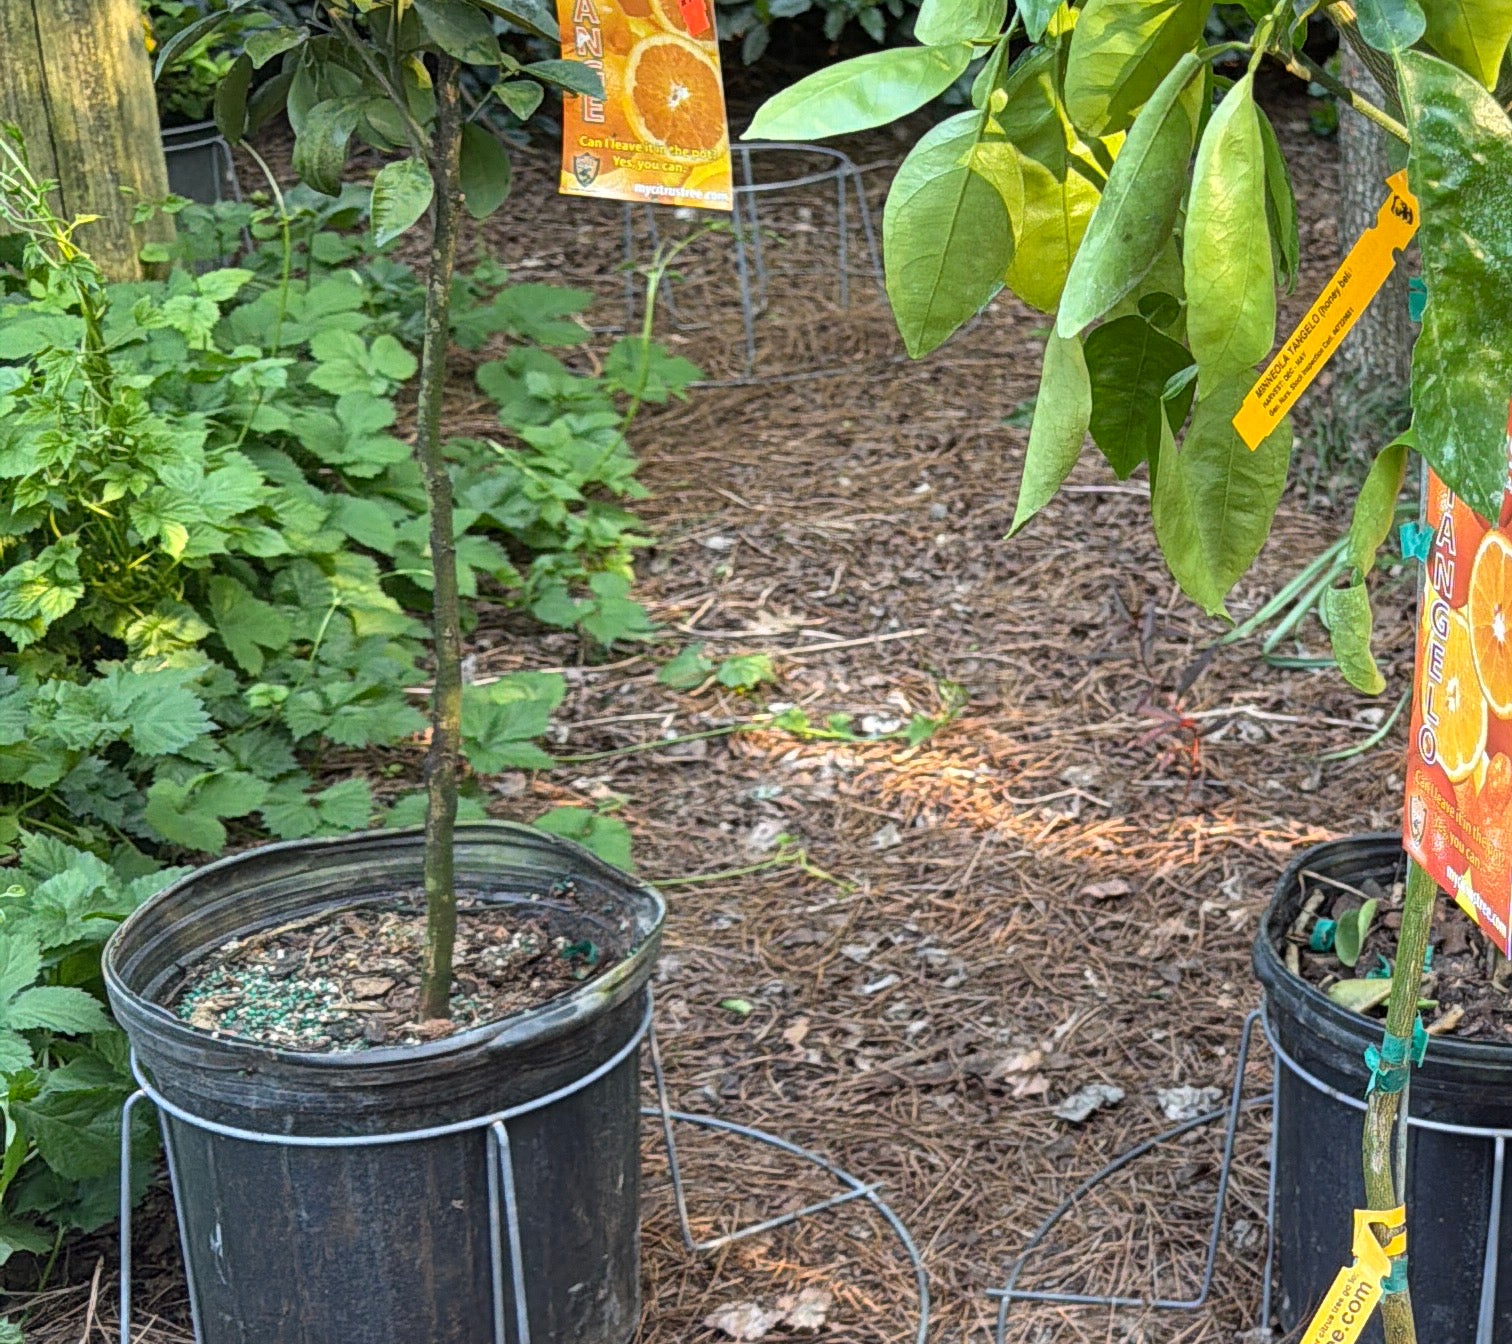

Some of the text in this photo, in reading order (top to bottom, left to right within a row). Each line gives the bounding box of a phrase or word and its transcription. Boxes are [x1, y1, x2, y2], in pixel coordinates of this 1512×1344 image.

[578, 135, 602, 148] Can
[611, 138, 642, 153] leave
[645, 142, 653, 153] it
[670, 146, 689, 157] the
[613, 156, 687, 173] Yes, you can.
[634, 183, 728, 201] mycitrustree.com
[1255, 354, 1290, 398] MINNEOLA
[1287, 314, 1320, 355] TANGELO
[1283, 368, 1294, 381] DEC
[1415, 770, 1431, 795] Can
[1436, 792, 1454, 817] leave
[1456, 810, 1463, 827] it
[1463, 821, 1472, 835] in
[1472, 825, 1490, 849] the
[1449, 831, 1464, 853] you
[1319, 1314, 1334, 1338] citrus
[1332, 1298, 1344, 1313] tree
[1342, 1284, 1352, 1297] go
